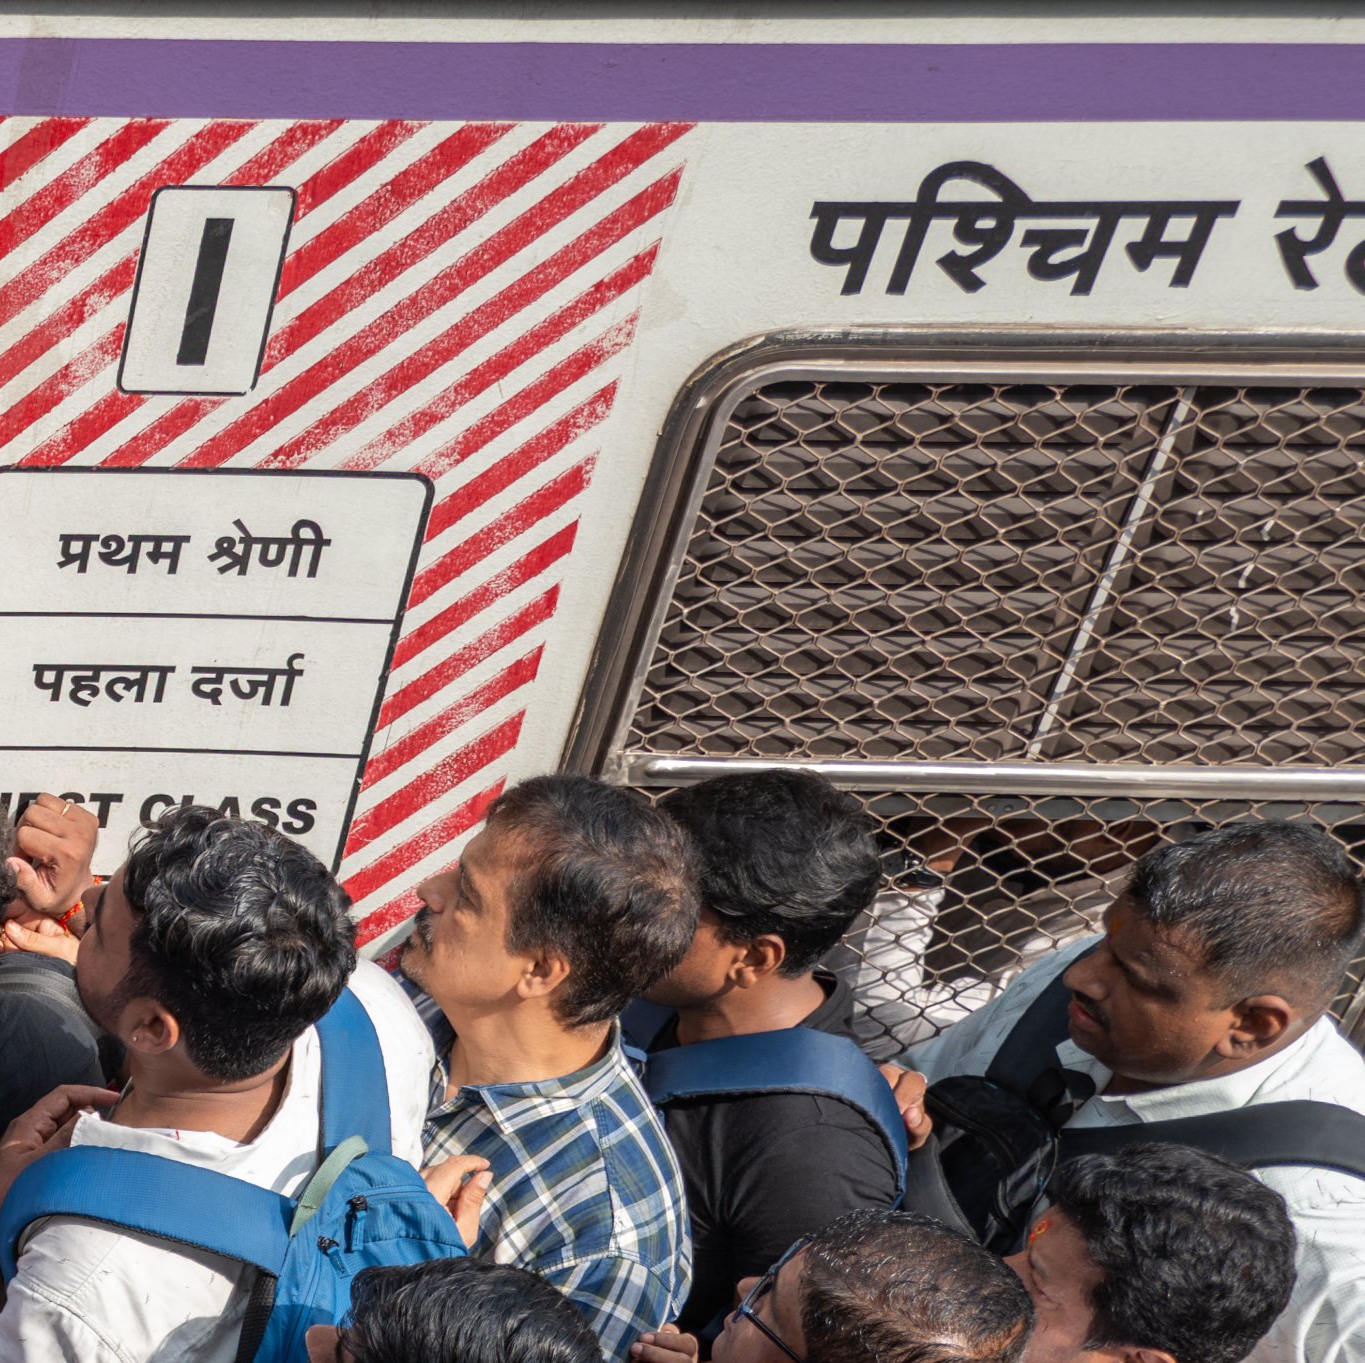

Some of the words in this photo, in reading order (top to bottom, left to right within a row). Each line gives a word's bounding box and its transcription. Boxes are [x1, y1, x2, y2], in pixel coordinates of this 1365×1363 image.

[809, 160, 1241, 296] पश्चिम
[1274, 156, 1365, 294] रे
[56, 533, 192, 575] प्रथम
[207, 518, 332, 578] श्रेणी
[32, 663, 176, 707] पहला
[190, 652, 305, 707] दर्जा
